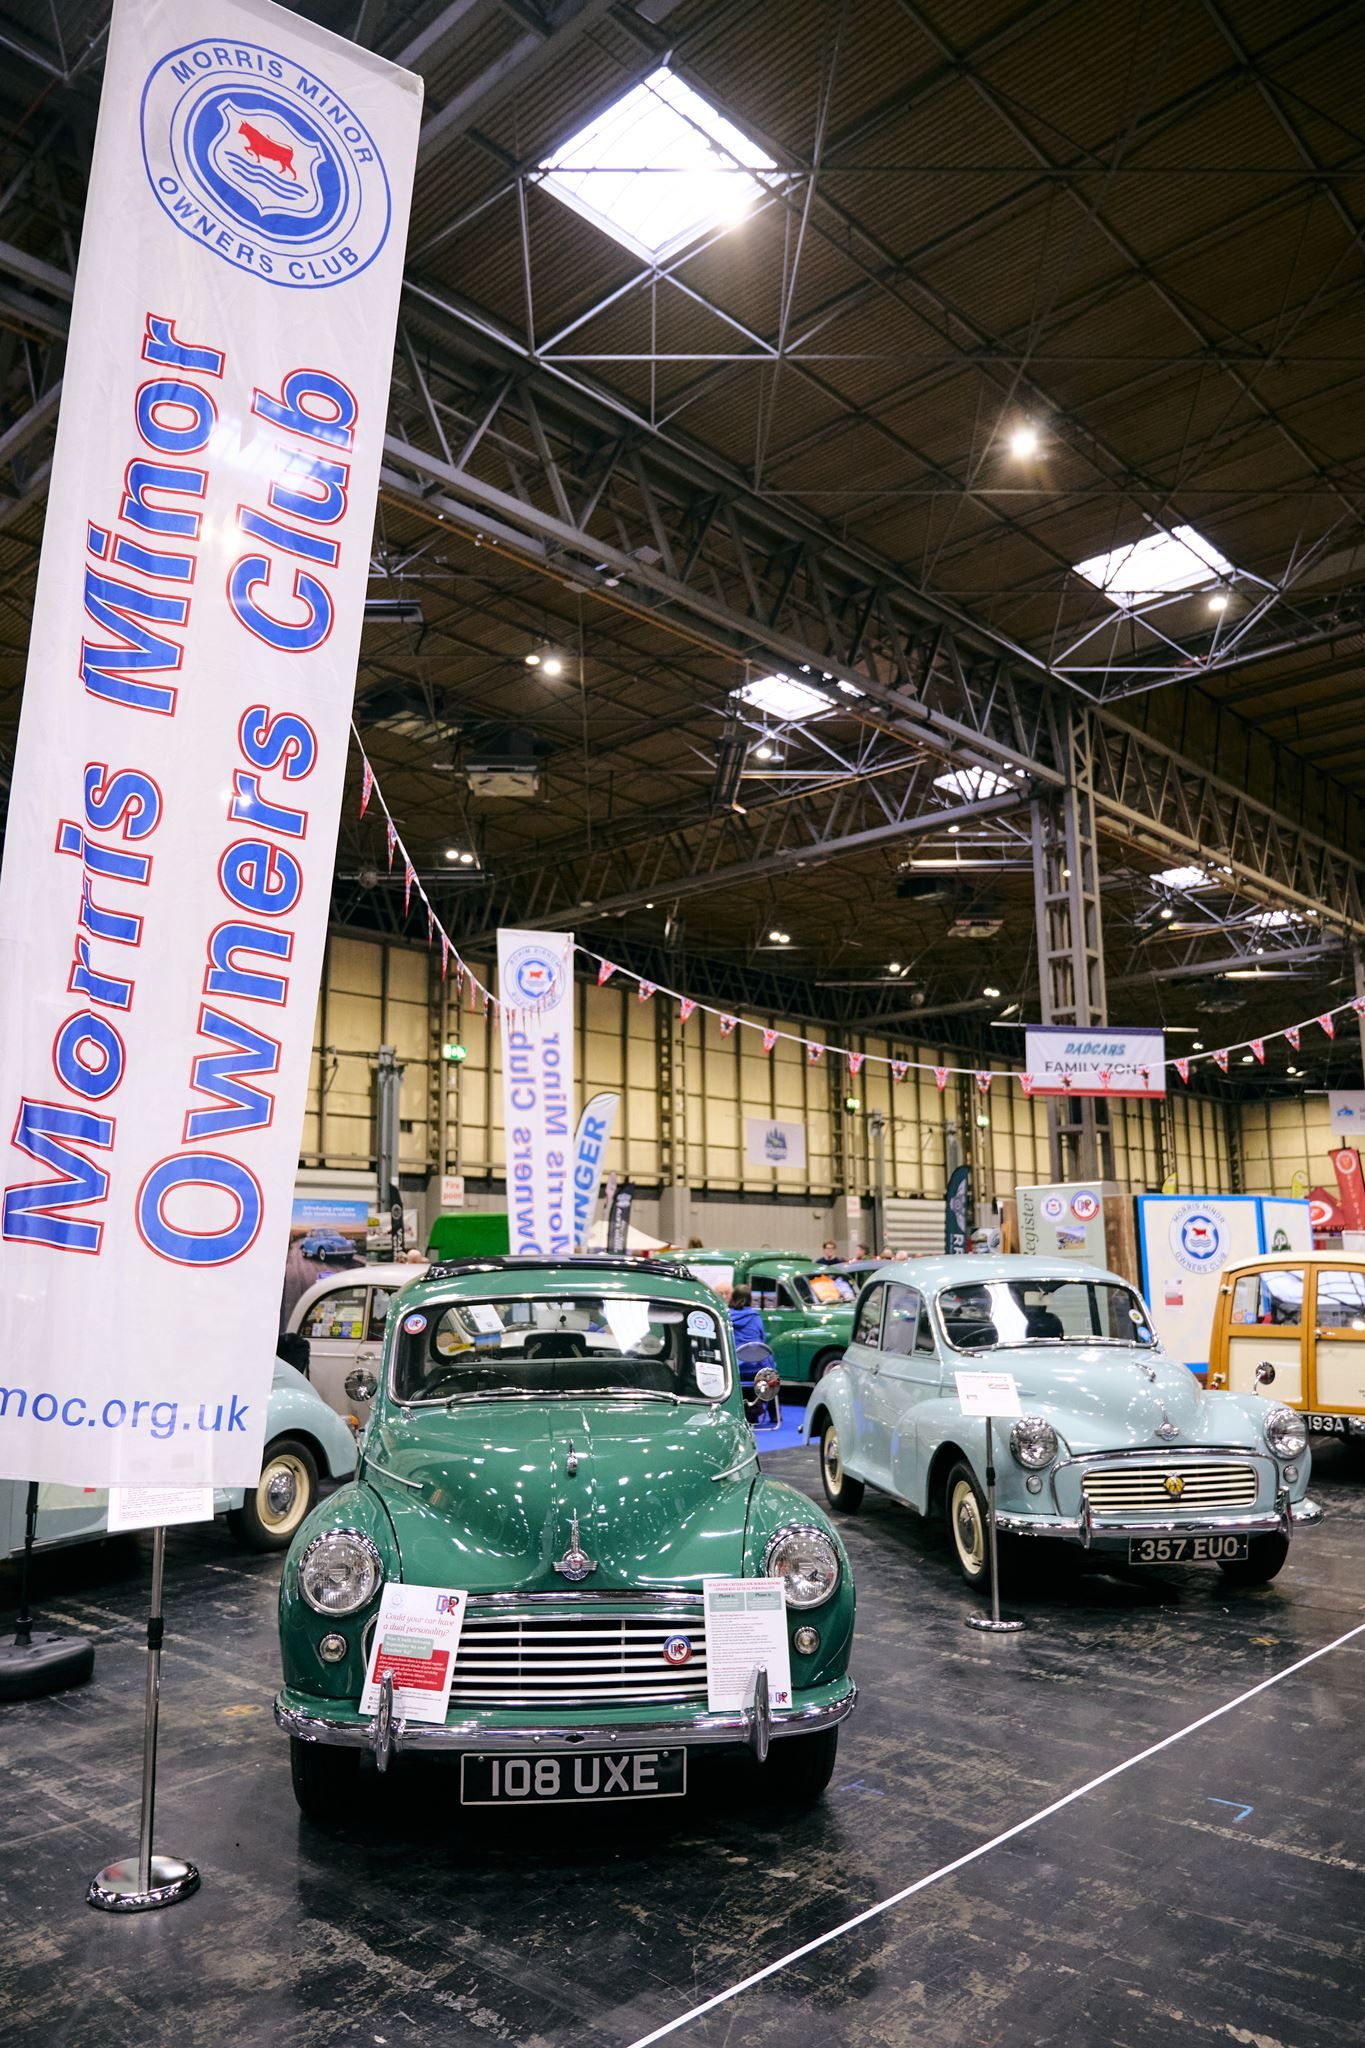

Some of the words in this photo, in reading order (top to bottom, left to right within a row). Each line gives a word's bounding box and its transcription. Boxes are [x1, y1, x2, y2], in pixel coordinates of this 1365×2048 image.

[171, 48, 284, 85] MORRIS
[297, 75, 374, 166] MINOR
[158, 175, 275, 275] OWNERS
[288, 245, 361, 282] CLUB
[79, 312, 226, 717] Minor
[226, 367, 359, 654] Club
[135, 703, 318, 1269] Owners
[2, 762, 164, 1256] Morris
[1045, 1061, 1100, 1073] FAMILY
[1173, 1204, 1200, 1223] MORRIS
[1202, 1203, 1226, 1224] MINOR
[1175, 1251, 1208, 1272] OWNERS
[1140, 1538, 1187, 1561] 357
[1193, 1536, 1239, 1560] EUO
[385, 1612, 406, 1621] Could
[407, 1616, 424, 1624] your
[438, 1617, 455, 1627] have
[389, 1623, 406, 1632] dual
[406, 1625, 450, 1637] personality?
[491, 1759, 561, 1796] 108
[574, 1754, 659, 1794] UXE
